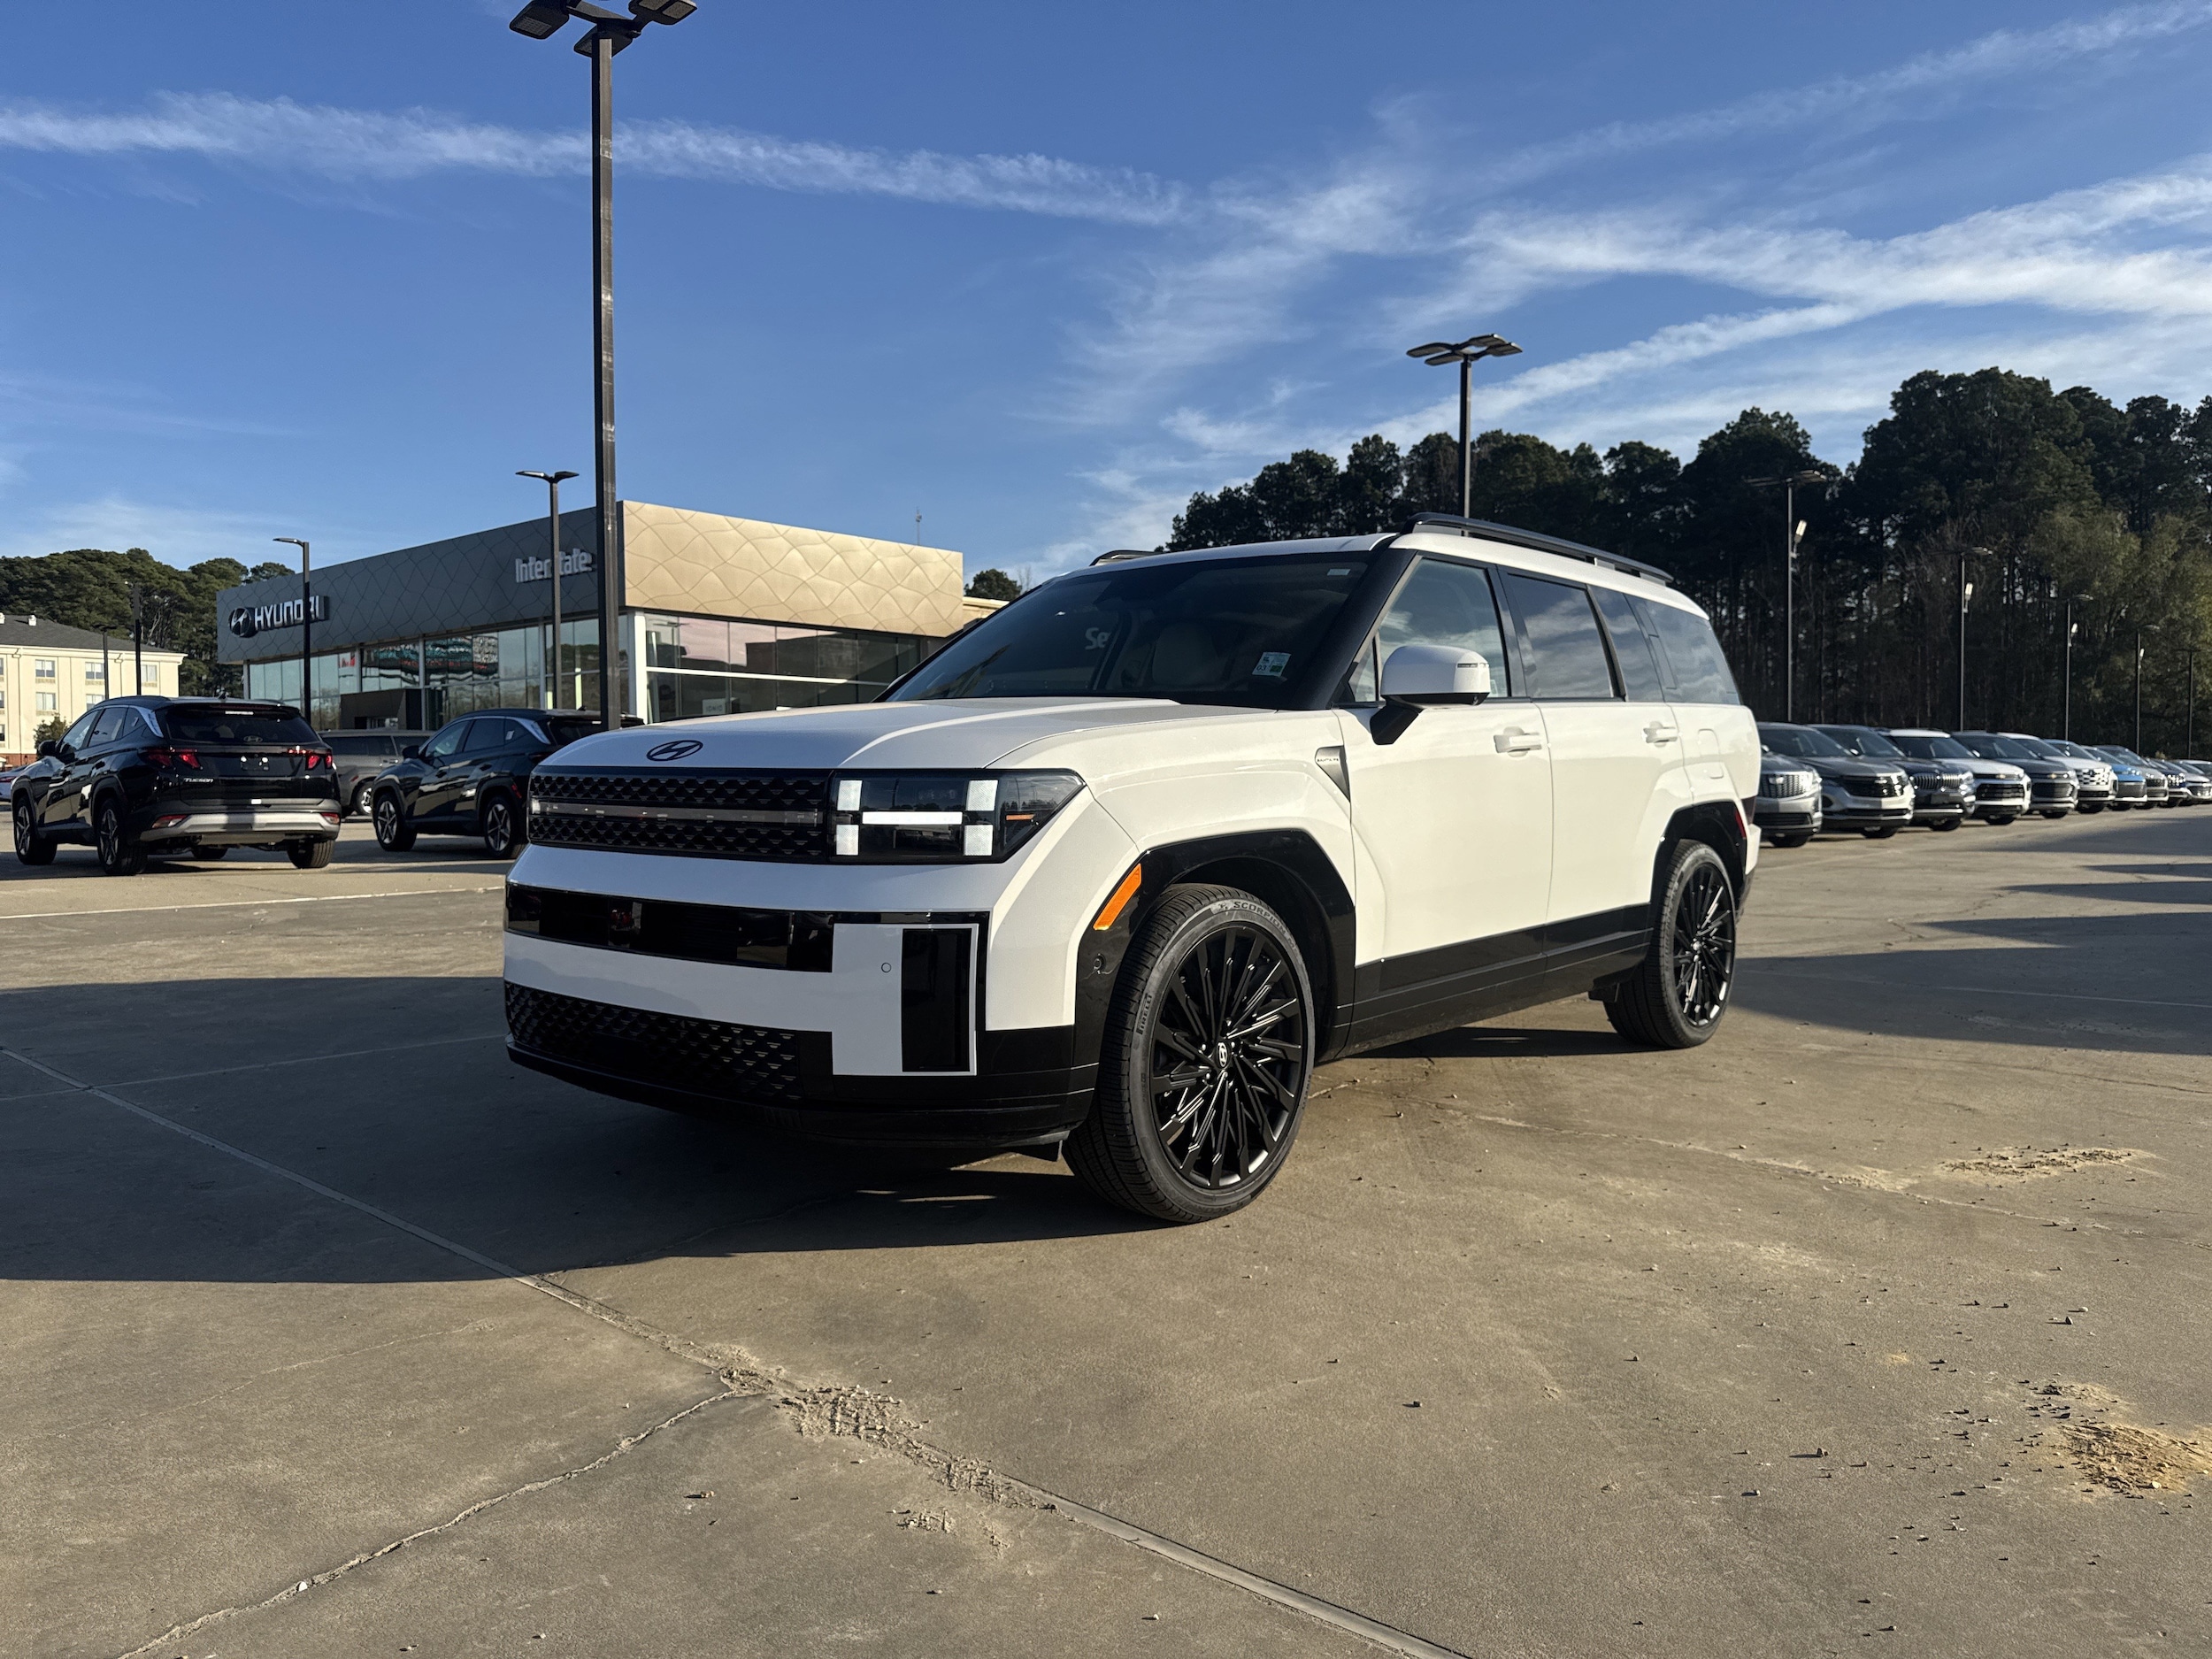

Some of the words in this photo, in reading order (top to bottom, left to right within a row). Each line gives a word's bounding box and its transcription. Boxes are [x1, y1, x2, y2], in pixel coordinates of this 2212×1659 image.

[515, 548, 592, 583] Intertate
[1233, 902, 1286, 935] SCORPION
[1136, 993, 1152, 1035] PIRELLI
